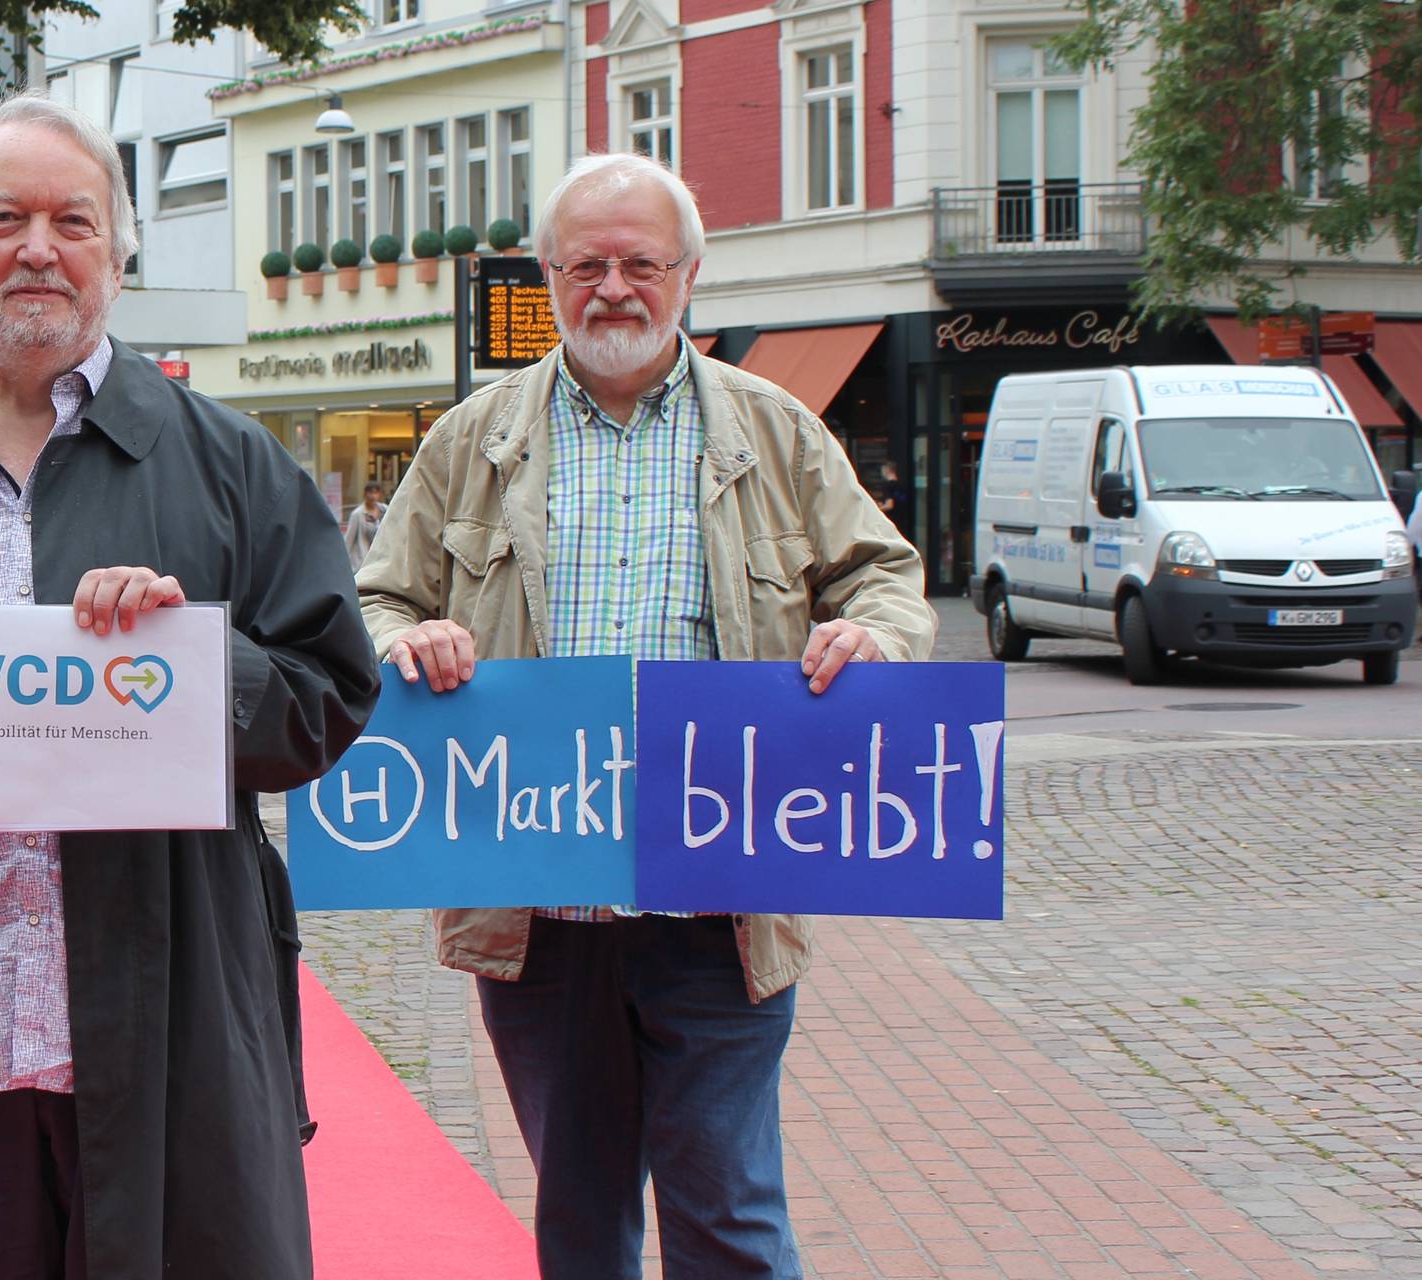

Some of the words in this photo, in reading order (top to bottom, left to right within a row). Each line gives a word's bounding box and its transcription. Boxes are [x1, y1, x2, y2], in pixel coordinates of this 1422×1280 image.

[489, 296, 507, 304] 400
[512, 305, 533, 314] Berg
[537, 305, 554, 313] Gla
[512, 314, 533, 323] Berg
[512, 332, 563, 341] Kürten-Olp
[936, 313, 1059, 353] Rathaus
[1064, 310, 1140, 354] Café
[512, 341, 558, 349] Herkenrat
[489, 351, 507, 359] 400
[512, 351, 533, 359] Berg
[238, 352, 327, 380] Parfümerie
[1153, 381, 1234, 396] GLAS
[45, 724, 67, 739] für
[71, 726, 154, 741] Menschen.
[444, 724, 636, 842] Markt
[682, 719, 1006, 861] bleibt!
